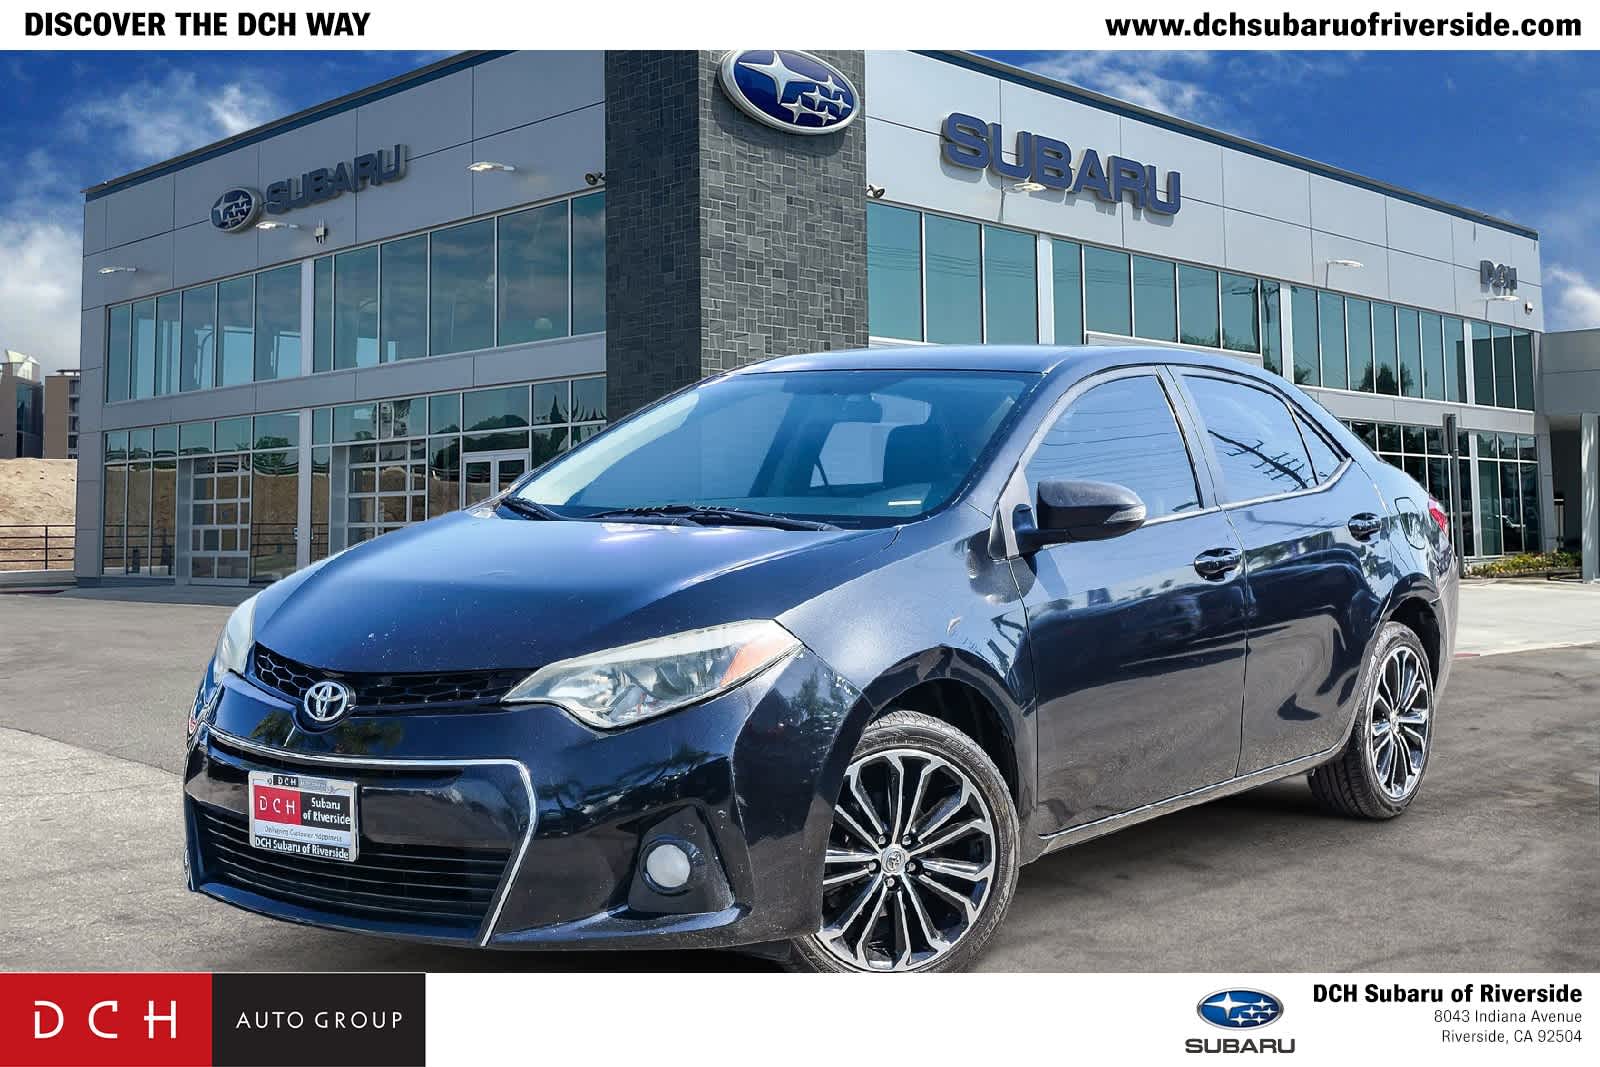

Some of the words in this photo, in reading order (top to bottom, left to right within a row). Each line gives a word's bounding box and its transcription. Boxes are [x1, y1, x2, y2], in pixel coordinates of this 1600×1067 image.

[940, 112, 1181, 215] SUBARU
[266, 143, 407, 215] SUBARU
[277, 776, 297, 786] DCH
[260, 795, 296, 815] DCH
[311, 797, 341, 810] Subaru
[302, 810, 312, 820] of
[313, 810, 351, 825] Riverside
[255, 836, 272, 849] DCH
[273, 838, 301, 853] Subaru
[302, 843, 311, 855] of
[312, 844, 349, 859] Riverside
